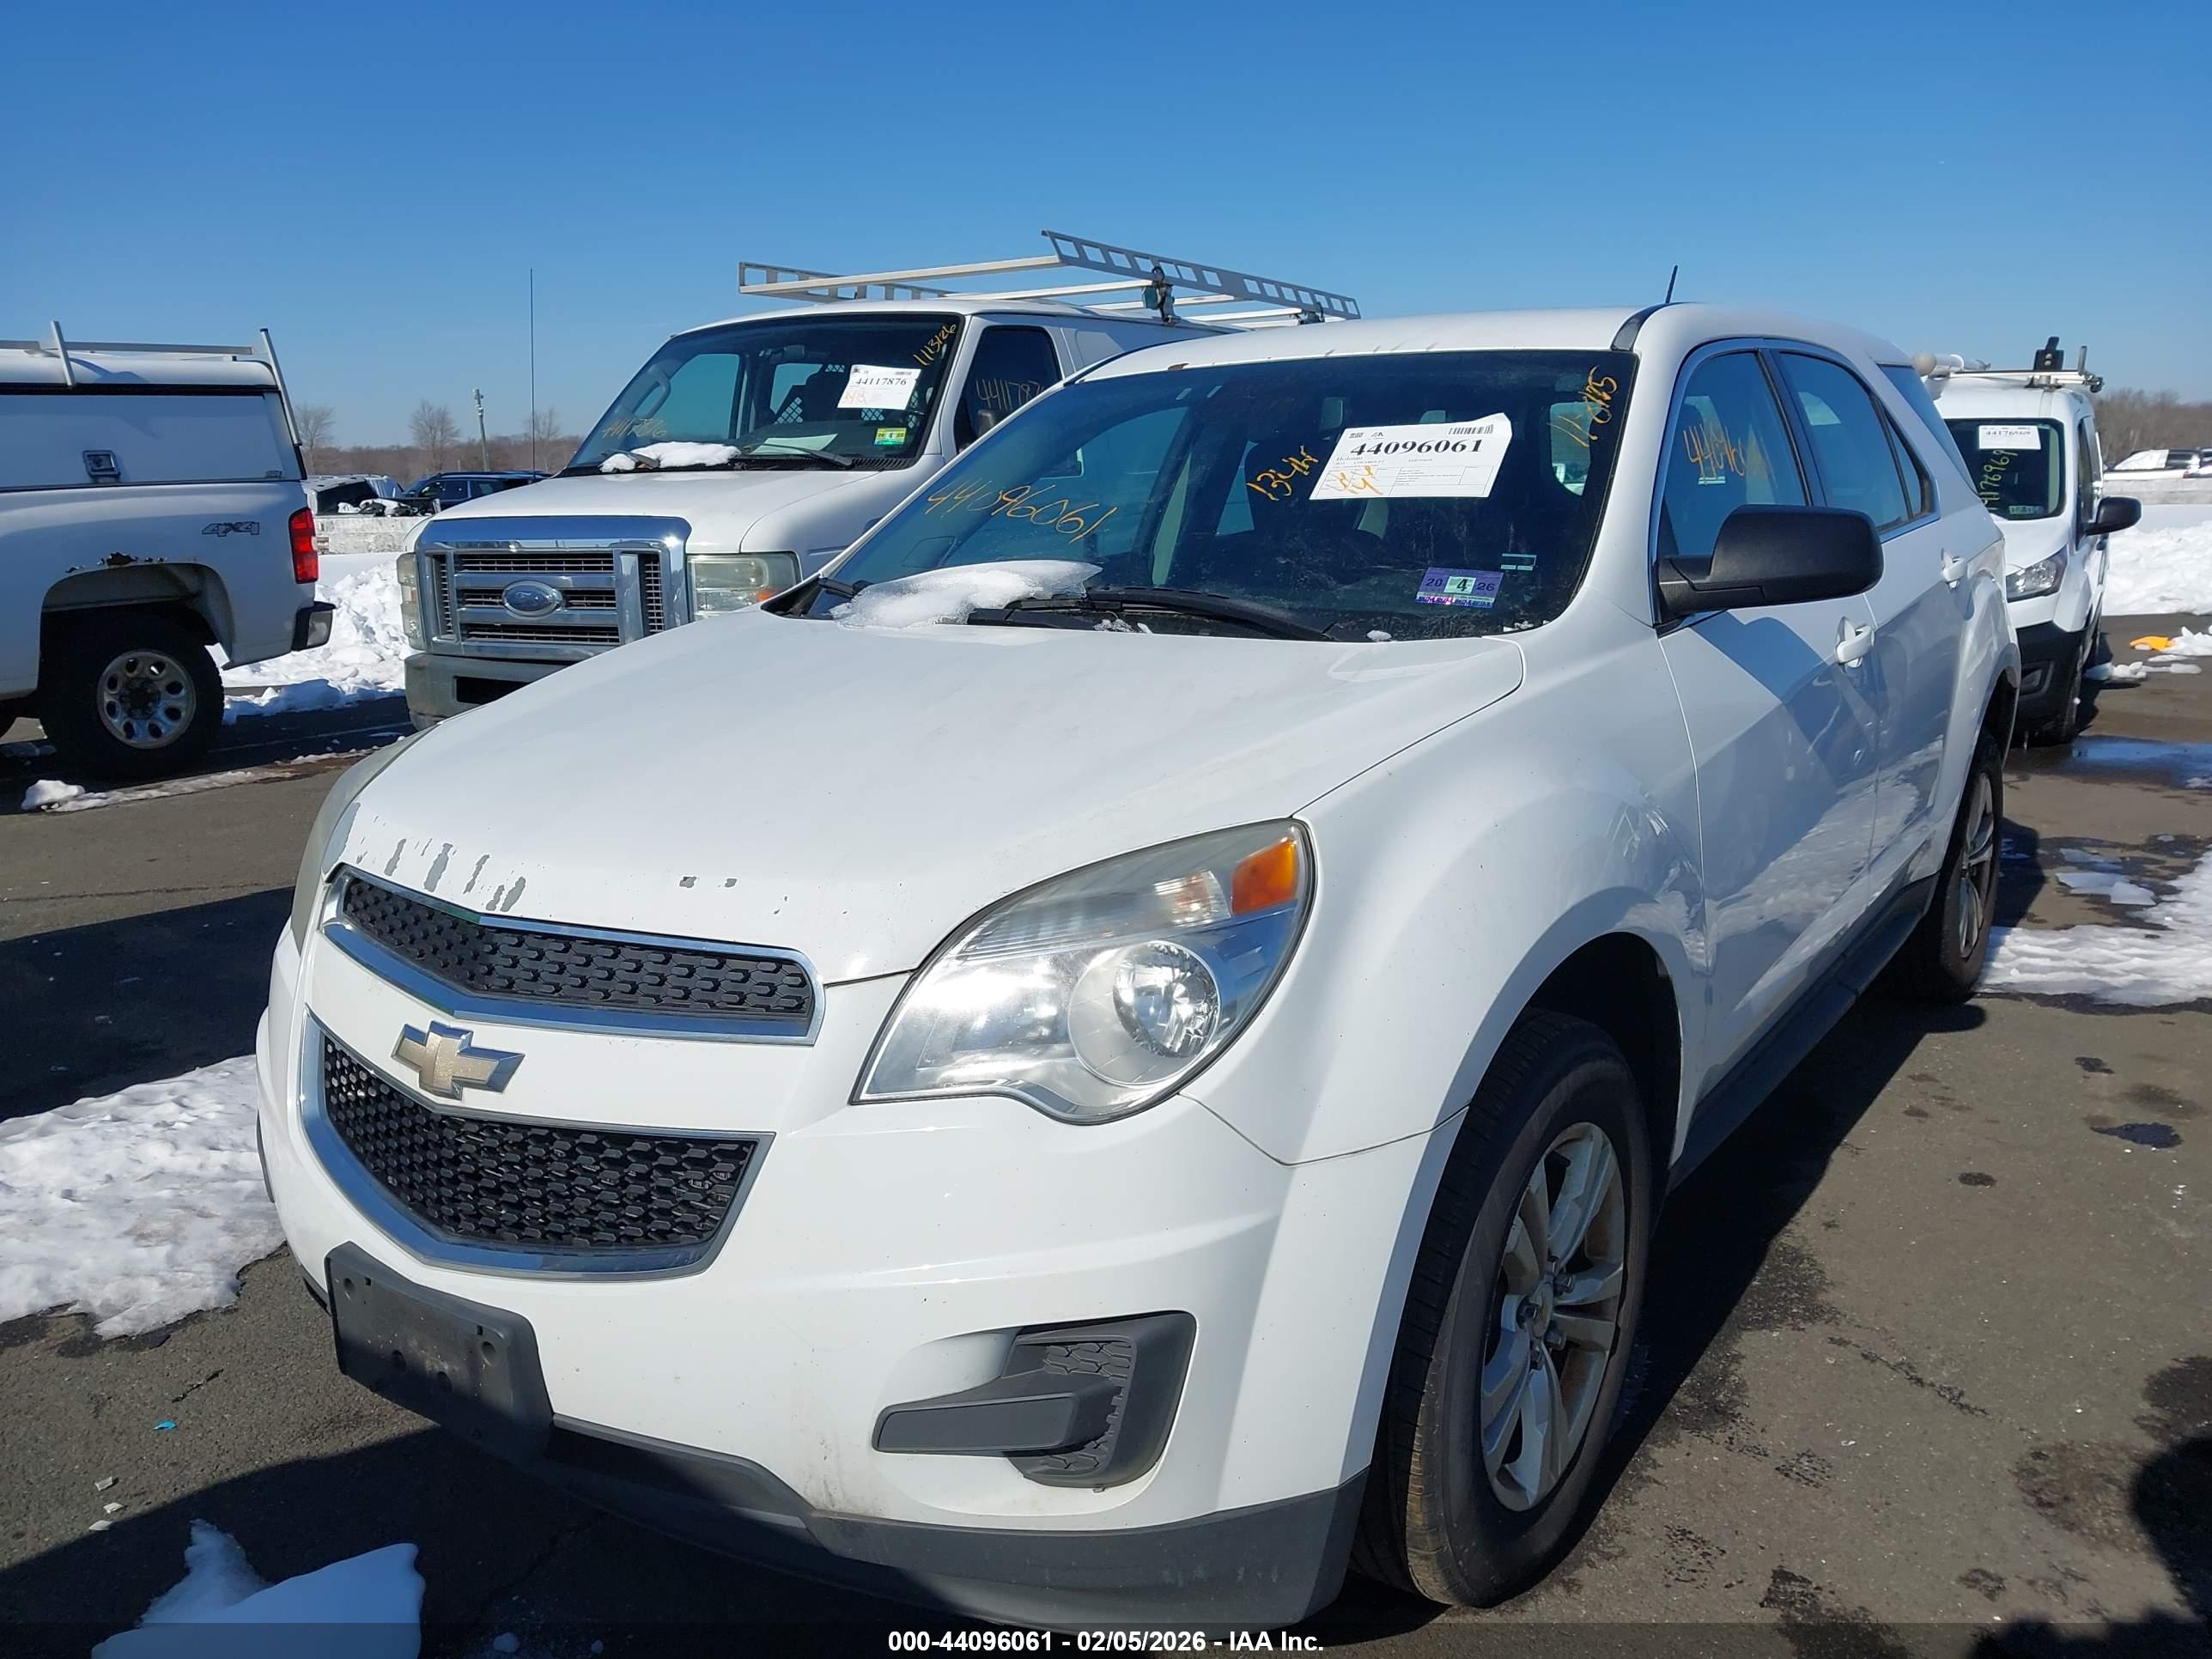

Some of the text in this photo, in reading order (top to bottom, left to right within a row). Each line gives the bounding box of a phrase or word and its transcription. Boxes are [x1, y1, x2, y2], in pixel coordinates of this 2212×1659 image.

[855, 377, 907, 386] 44117876
[975, 378, 1044, 410] 4411787
[1349, 439, 1483, 456] 44096061
[924, 477, 1117, 544] 44096061
[1425, 578, 1495, 592] 20 4 26
